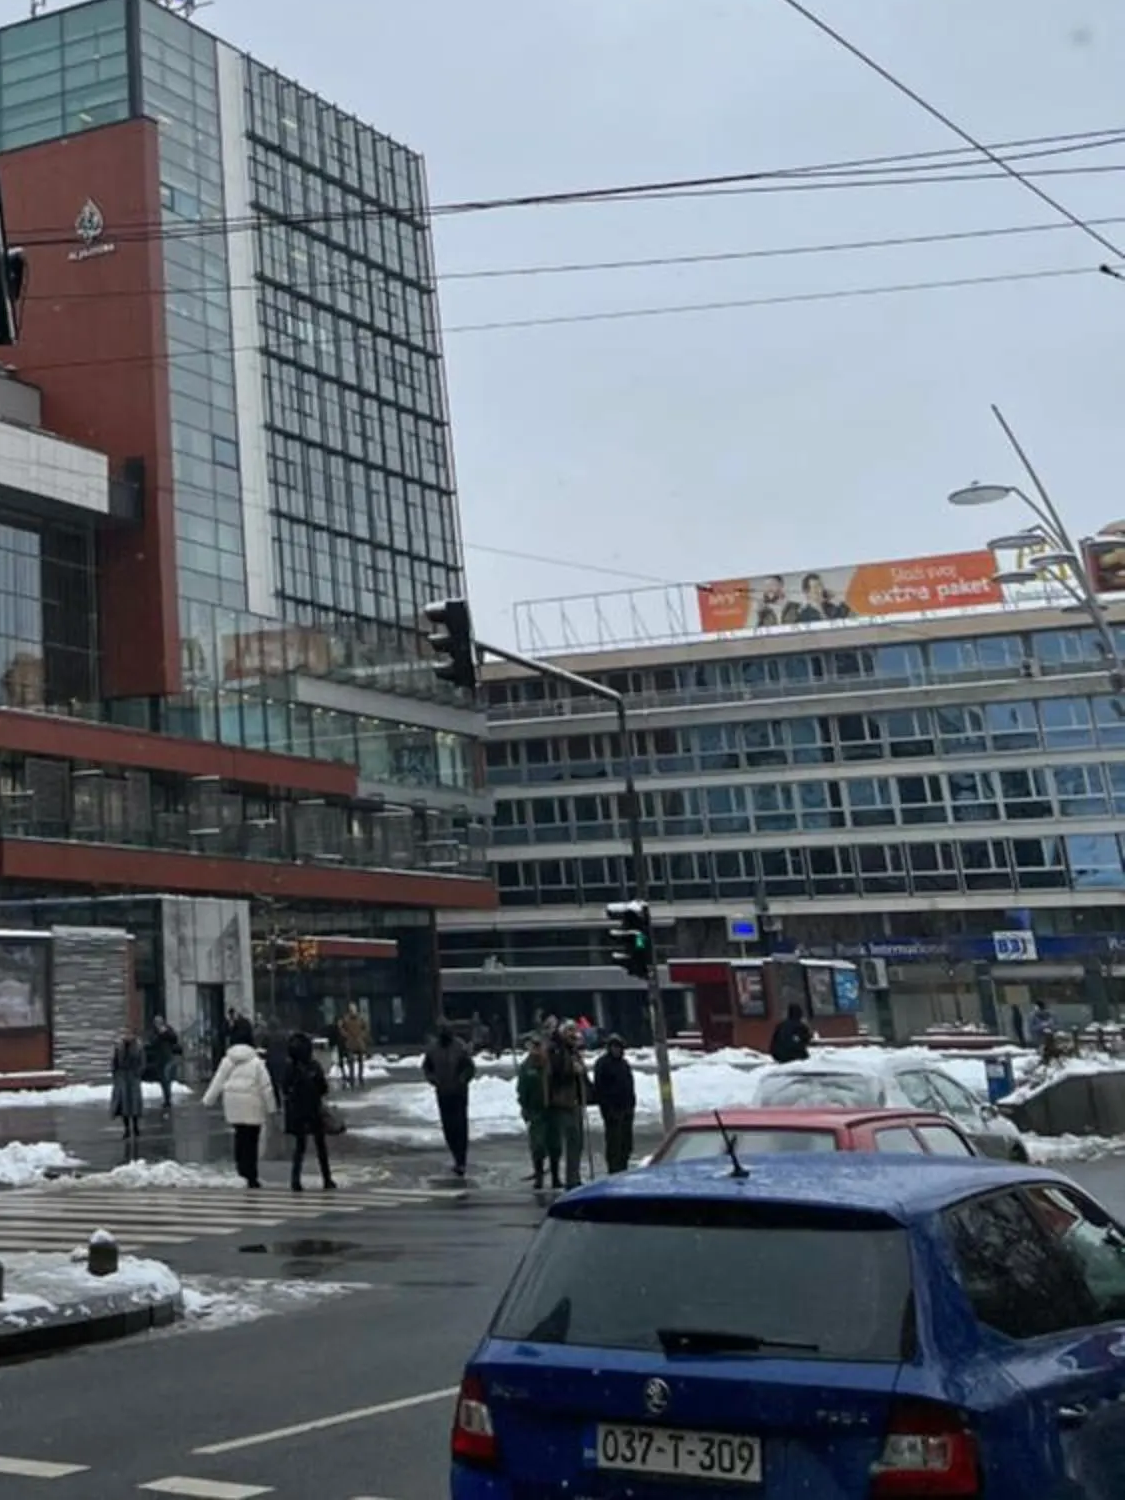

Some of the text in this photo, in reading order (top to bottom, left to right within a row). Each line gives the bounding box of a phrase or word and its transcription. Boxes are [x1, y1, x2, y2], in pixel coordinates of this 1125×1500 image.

[868, 583, 931, 606] extra
[936, 577, 991, 602] paket
[602, 1428, 756, 1476] 037-T-309
